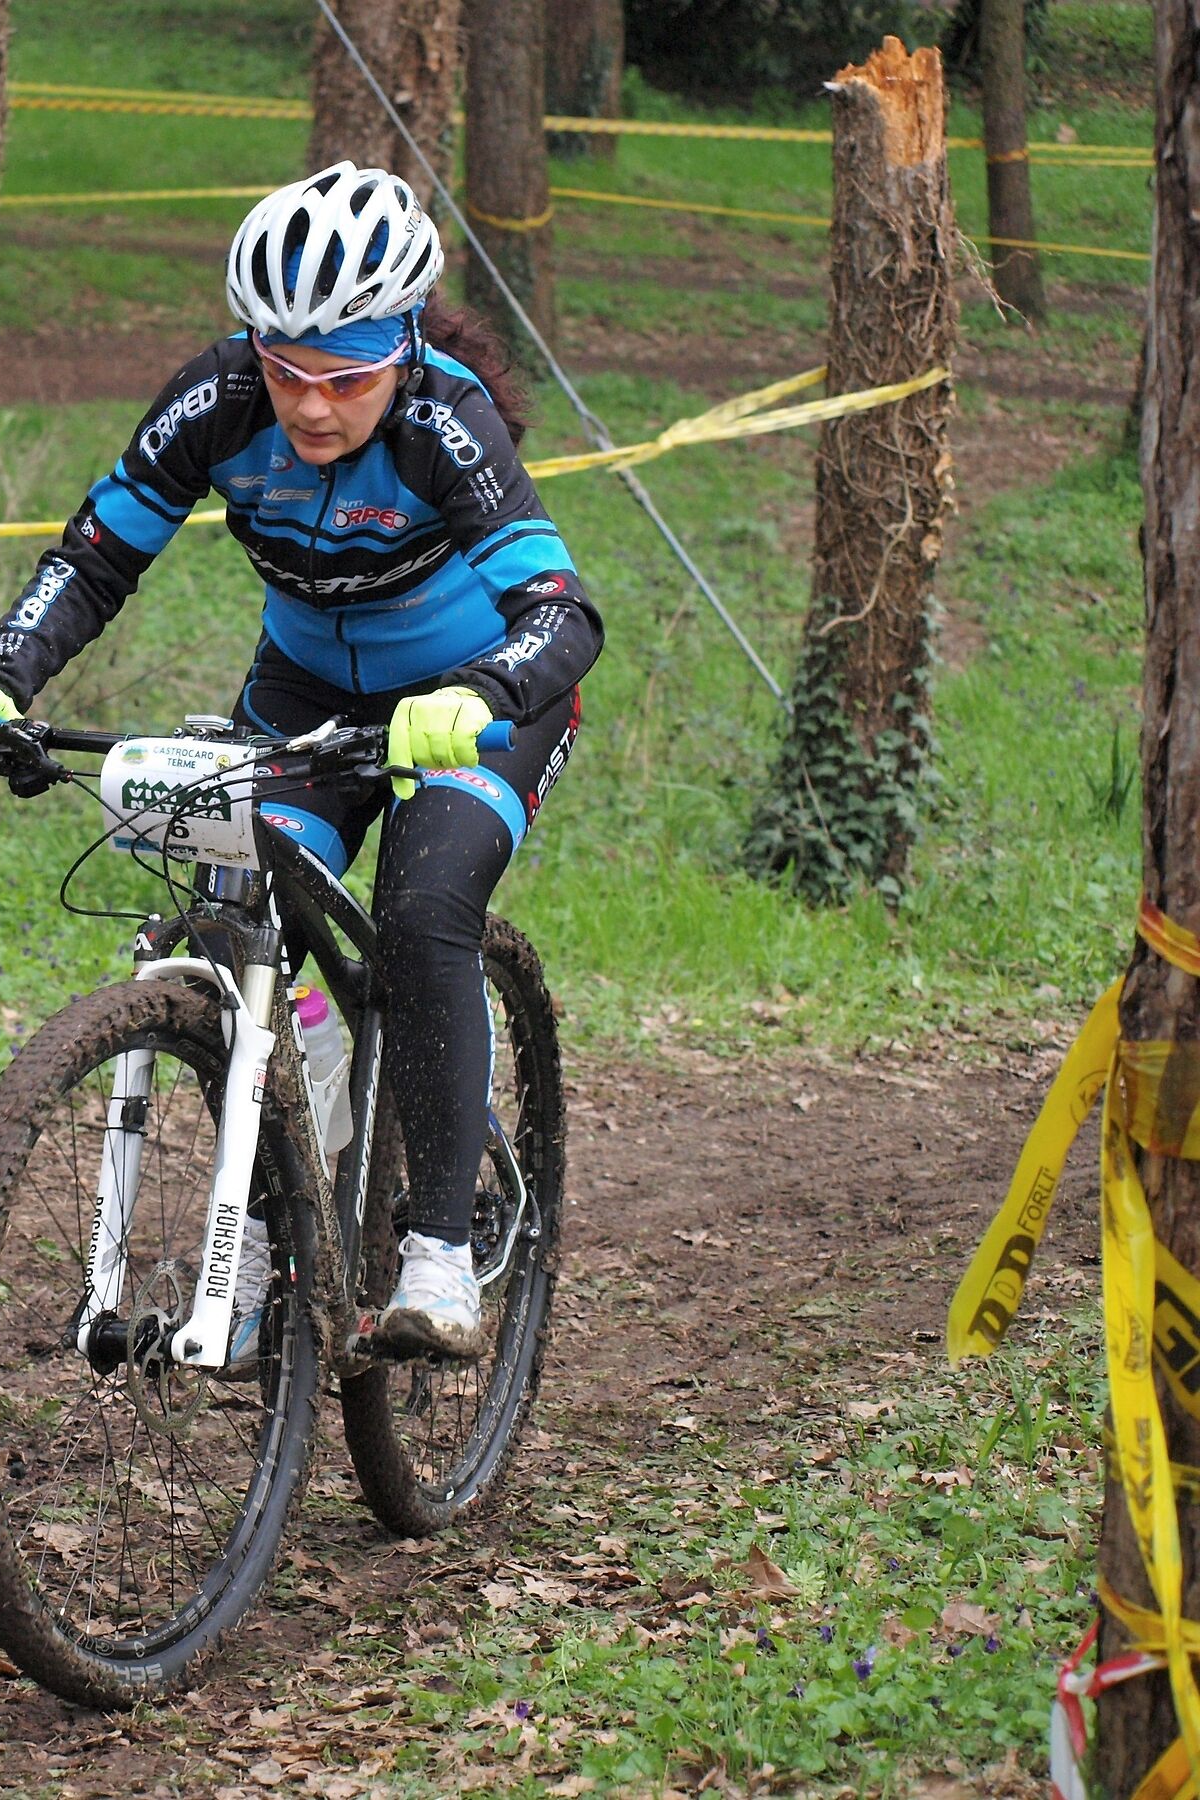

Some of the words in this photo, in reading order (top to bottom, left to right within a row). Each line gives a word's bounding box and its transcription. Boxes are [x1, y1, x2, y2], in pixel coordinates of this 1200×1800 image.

[139, 373, 220, 466] TORPED
[153, 746, 215, 760] CASTROCARO
[167, 757, 196, 769] TERME
[205, 1203, 240, 1299] ROCKSHOX
